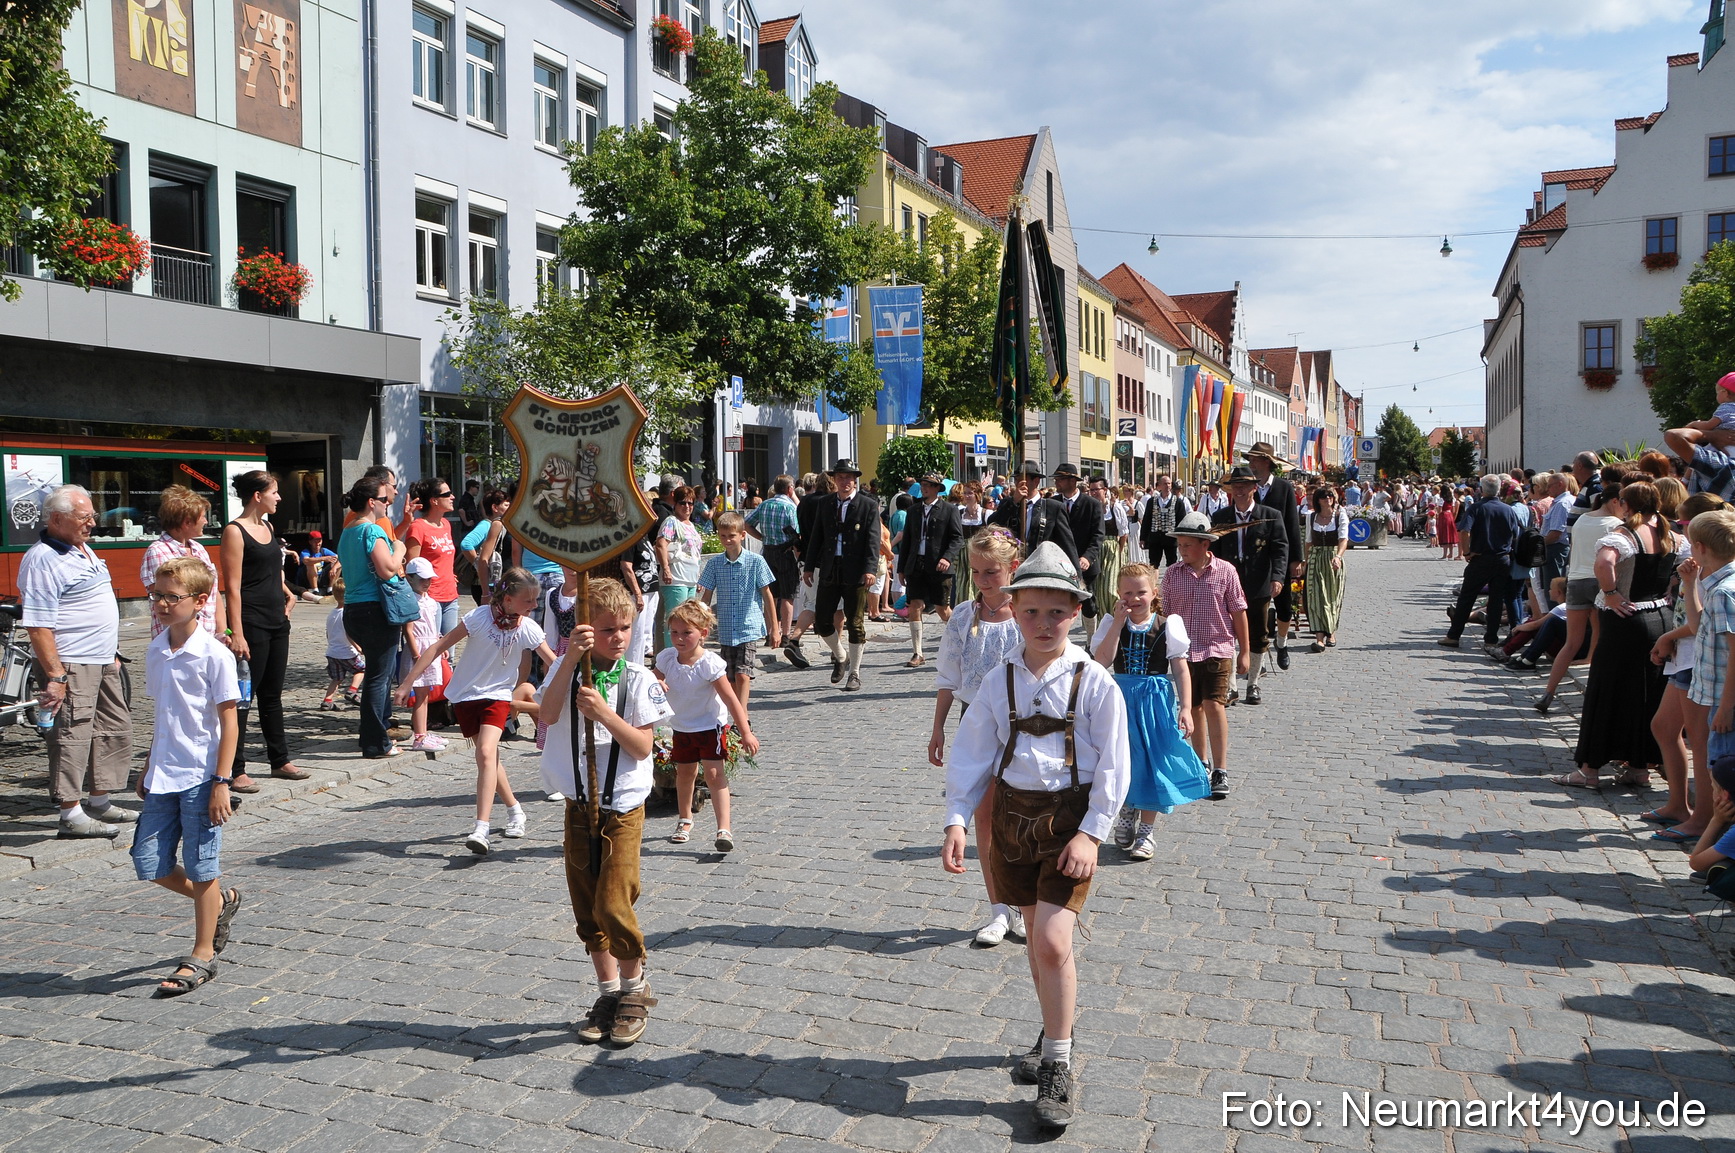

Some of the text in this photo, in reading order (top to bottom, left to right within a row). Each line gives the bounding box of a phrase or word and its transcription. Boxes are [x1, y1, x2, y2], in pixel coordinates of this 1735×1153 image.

[734, 380, 740, 403] P
[528, 403, 620, 425] ST. GEORG-
[533, 416, 620, 437] SCHÜTZEN
[976, 436, 984, 452] P
[521, 521, 611, 553] LODERBACH
